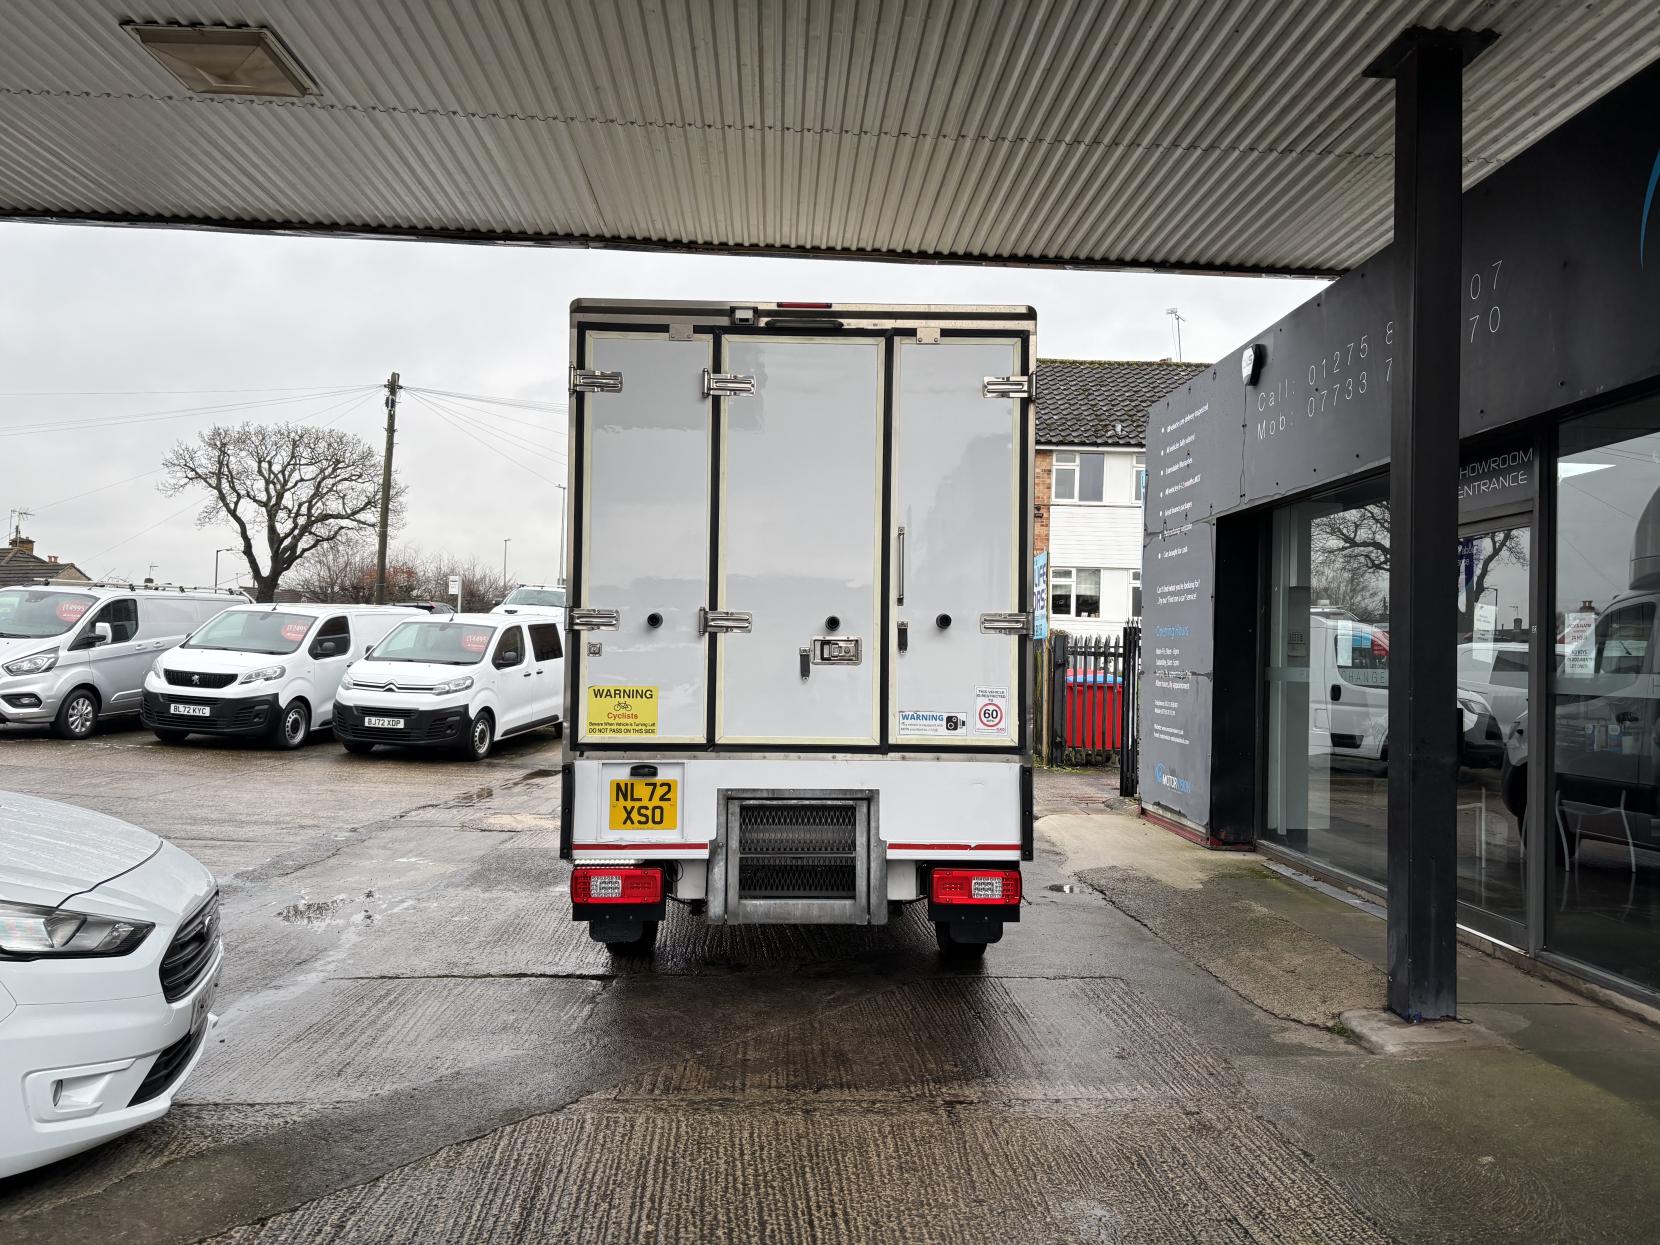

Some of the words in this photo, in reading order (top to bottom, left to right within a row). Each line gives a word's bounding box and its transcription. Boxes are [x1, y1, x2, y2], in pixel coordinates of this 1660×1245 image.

[1308, 334, 1368, 385] 01275
[1469, 259, 1503, 300] 07
[1307, 371, 1368, 417] 07733
[1468, 305, 1501, 343] 70
[1459, 447, 1533, 480] HOWROOM
[593, 688, 653, 700] WARNING
[173, 705, 191, 714] BL72
[192, 706, 207, 715] KYC
[983, 708, 999, 720] 60
[367, 718, 386, 727] BJ72
[607, 712, 638, 721] Cyclists
[901, 713, 944, 722] WARNING
[615, 782, 672, 802] NL72
[622, 805, 664, 825] XSO
